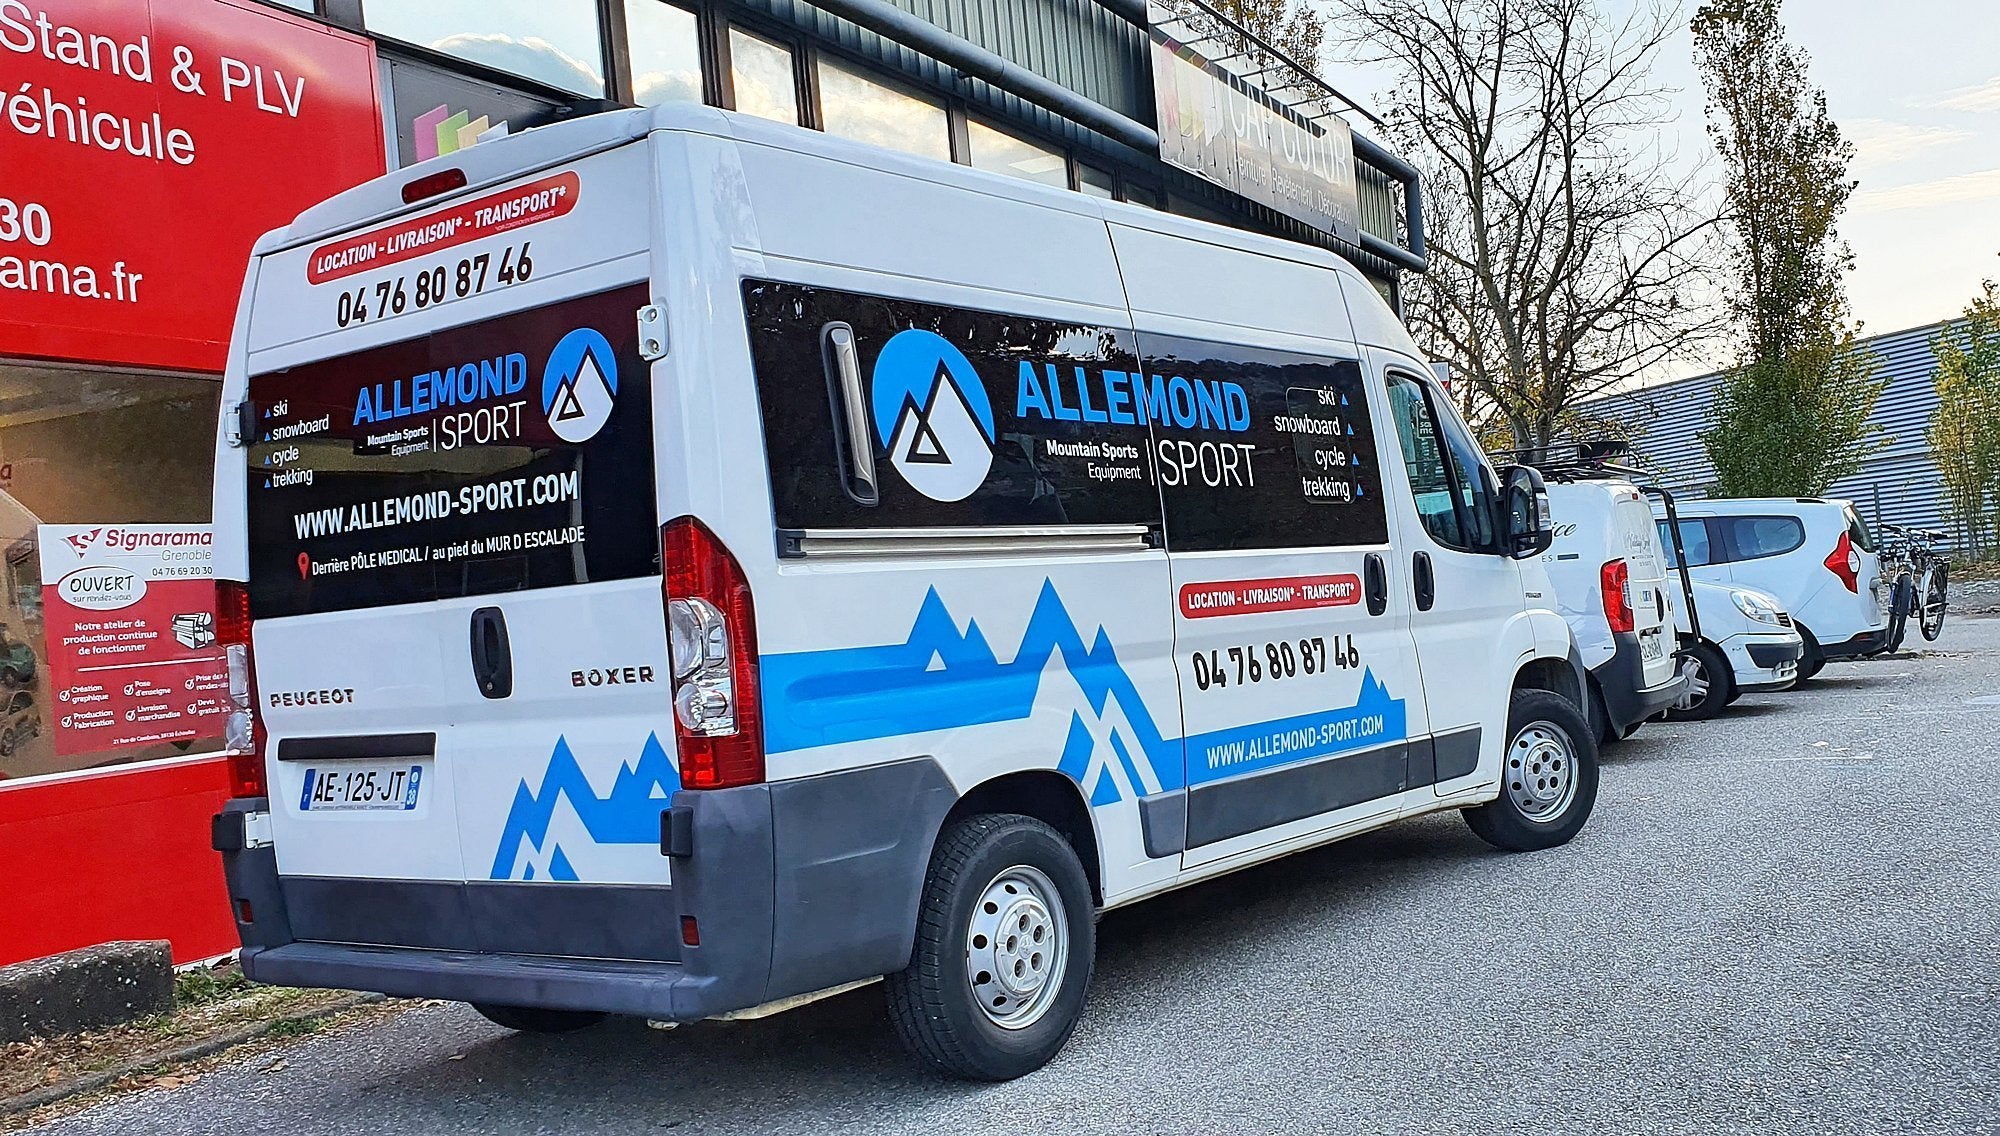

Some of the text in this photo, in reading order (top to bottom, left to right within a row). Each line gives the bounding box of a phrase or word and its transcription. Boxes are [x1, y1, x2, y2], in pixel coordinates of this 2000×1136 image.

[0, 0, 306, 118] Stand & PLV
[0, 197, 53, 247] 30
[317, 241, 377, 275] LOCATION
[336, 241, 533, 328] 04 76 80 87 46
[352, 353, 527, 426] ALLEMOND
[1016, 360, 1252, 432] ALLEMOND
[1317, 388, 1336, 407] ski
[273, 399, 288, 418] ski
[272, 415, 330, 442] snowboard
[441, 401, 527, 451] SPORT
[1274, 413, 1340, 435] snowboard
[367, 425, 429, 447] Mountain Sports
[272, 445, 300, 467] cycle
[391, 440, 430, 458] Equipment
[1046, 439, 1139, 462] Mountain Sports
[1315, 447, 1346, 468] cycle
[1087, 462, 1142, 481] Equipment
[1161, 439, 1256, 488] SPORT
[272, 467, 313, 489] trekking
[1302, 475, 1351, 501] trekking
[294, 470, 580, 540] WWW.ALLEMOND-SPORT.COM
[105, 529, 213, 551] Signarama
[161, 549, 212, 561] Grenoble
[311, 557, 350, 577] Derrière
[350, 550, 378, 572] PÔLE
[378, 546, 423, 567] MEDICAL
[432, 547, 446, 562] au
[447, 540, 470, 561] pied
[470, 540, 485, 557] du
[486, 535, 512, 554] MUR
[513, 534, 523, 551] D
[524, 525, 586, 550] ESCALADE
[152, 566, 213, 577] 04 76 69 20 30
[70, 575, 135, 593] OUVERT
[86, 594, 132, 603] rendez-vous
[1188, 590, 1236, 609] LOCATION
[74, 619, 146, 632] Notre atelier de
[63, 630, 158, 646] production continue
[78, 643, 147, 656] de fonctionner
[1192, 634, 1360, 692] 04 76 80 87 46
[135, 680, 151, 689] Pose
[570, 664, 656, 688] BOXER
[71, 684, 103, 695] Création
[72, 692, 109, 705] graphique
[269, 688, 355, 708] PEUGEOT
[137, 703, 168, 713] Livraison
[197, 698, 215, 706] Devis
[73, 709, 114, 721] Production
[73, 718, 115, 730] Fabrication
[137, 711, 181, 722] marchandise
[1206, 714, 1384, 770] WWW.ALLEMOND-SPORT.COM
[313, 771, 407, 802] AE-125-JT
